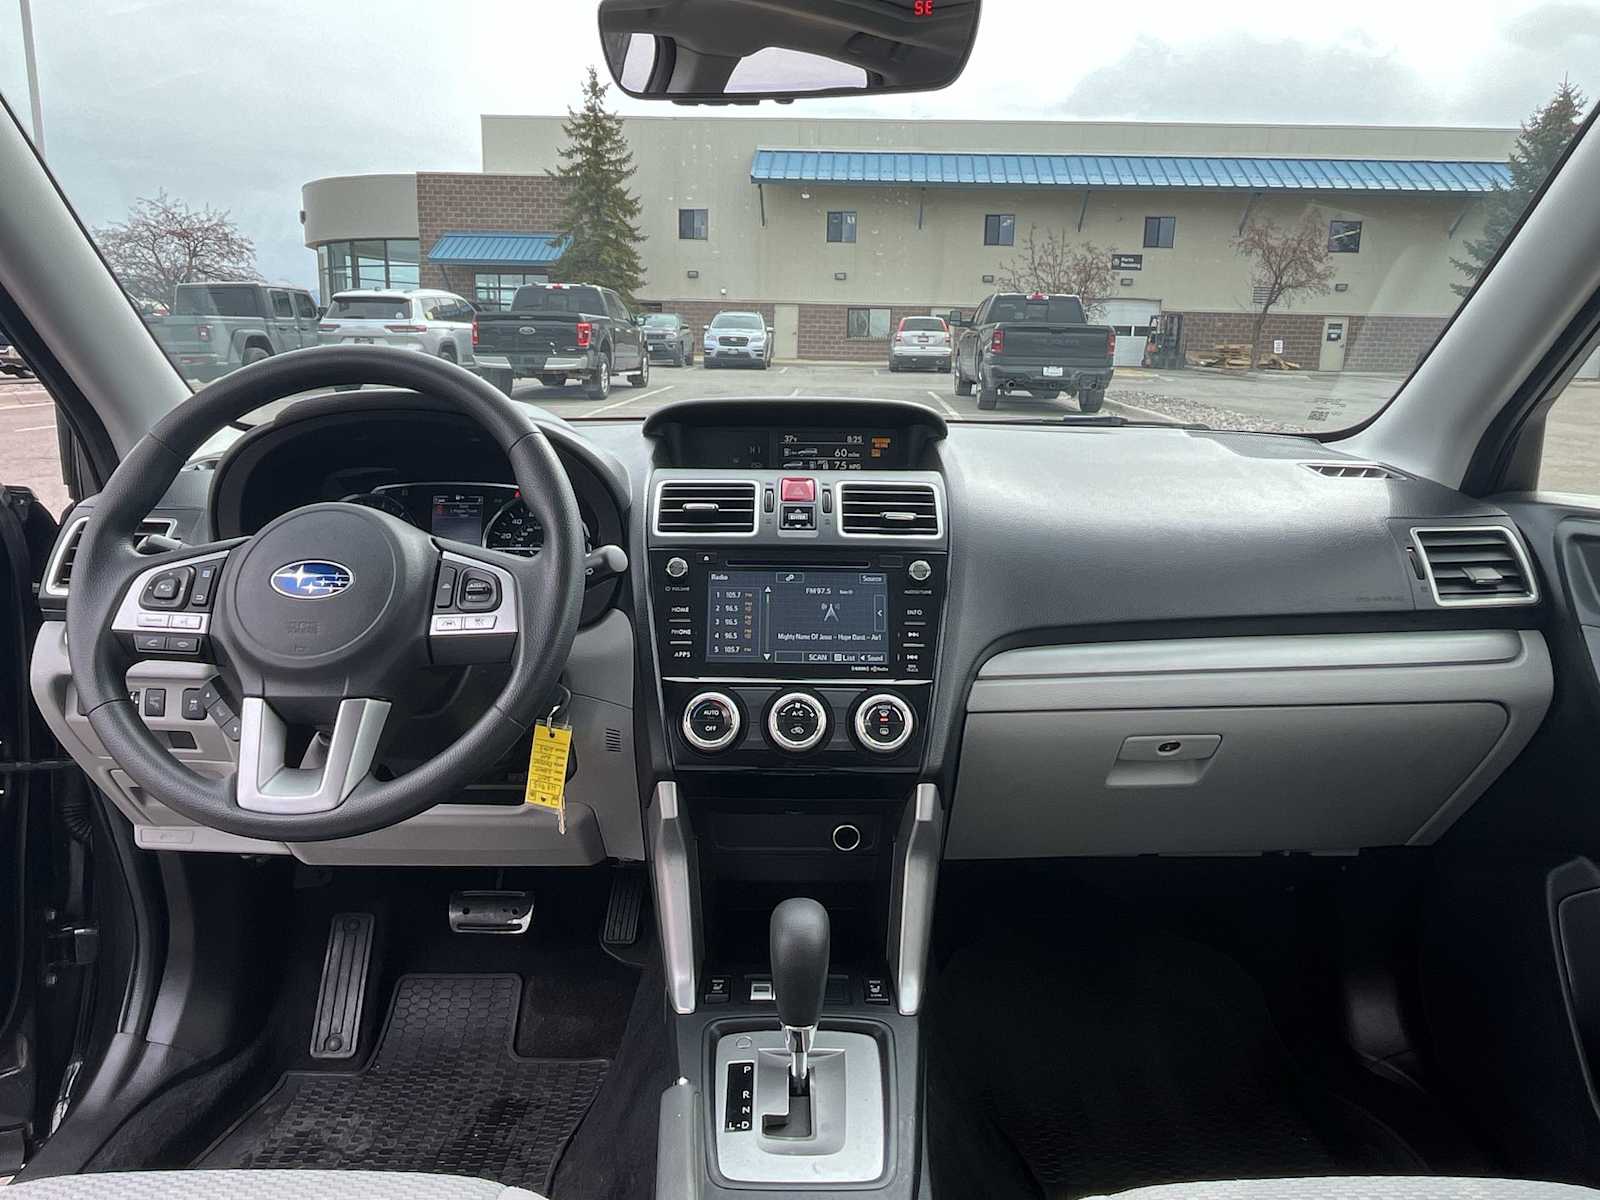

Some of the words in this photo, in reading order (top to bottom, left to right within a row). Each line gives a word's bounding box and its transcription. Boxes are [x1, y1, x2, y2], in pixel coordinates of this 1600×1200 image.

[834, 448, 848, 457] 60
[777, 633, 795, 641] Mighty
[705, 724, 717, 732] OFF
[743, 1066, 752, 1074] P
[742, 1090, 751, 1099] R
[742, 1106, 751, 1114] N
